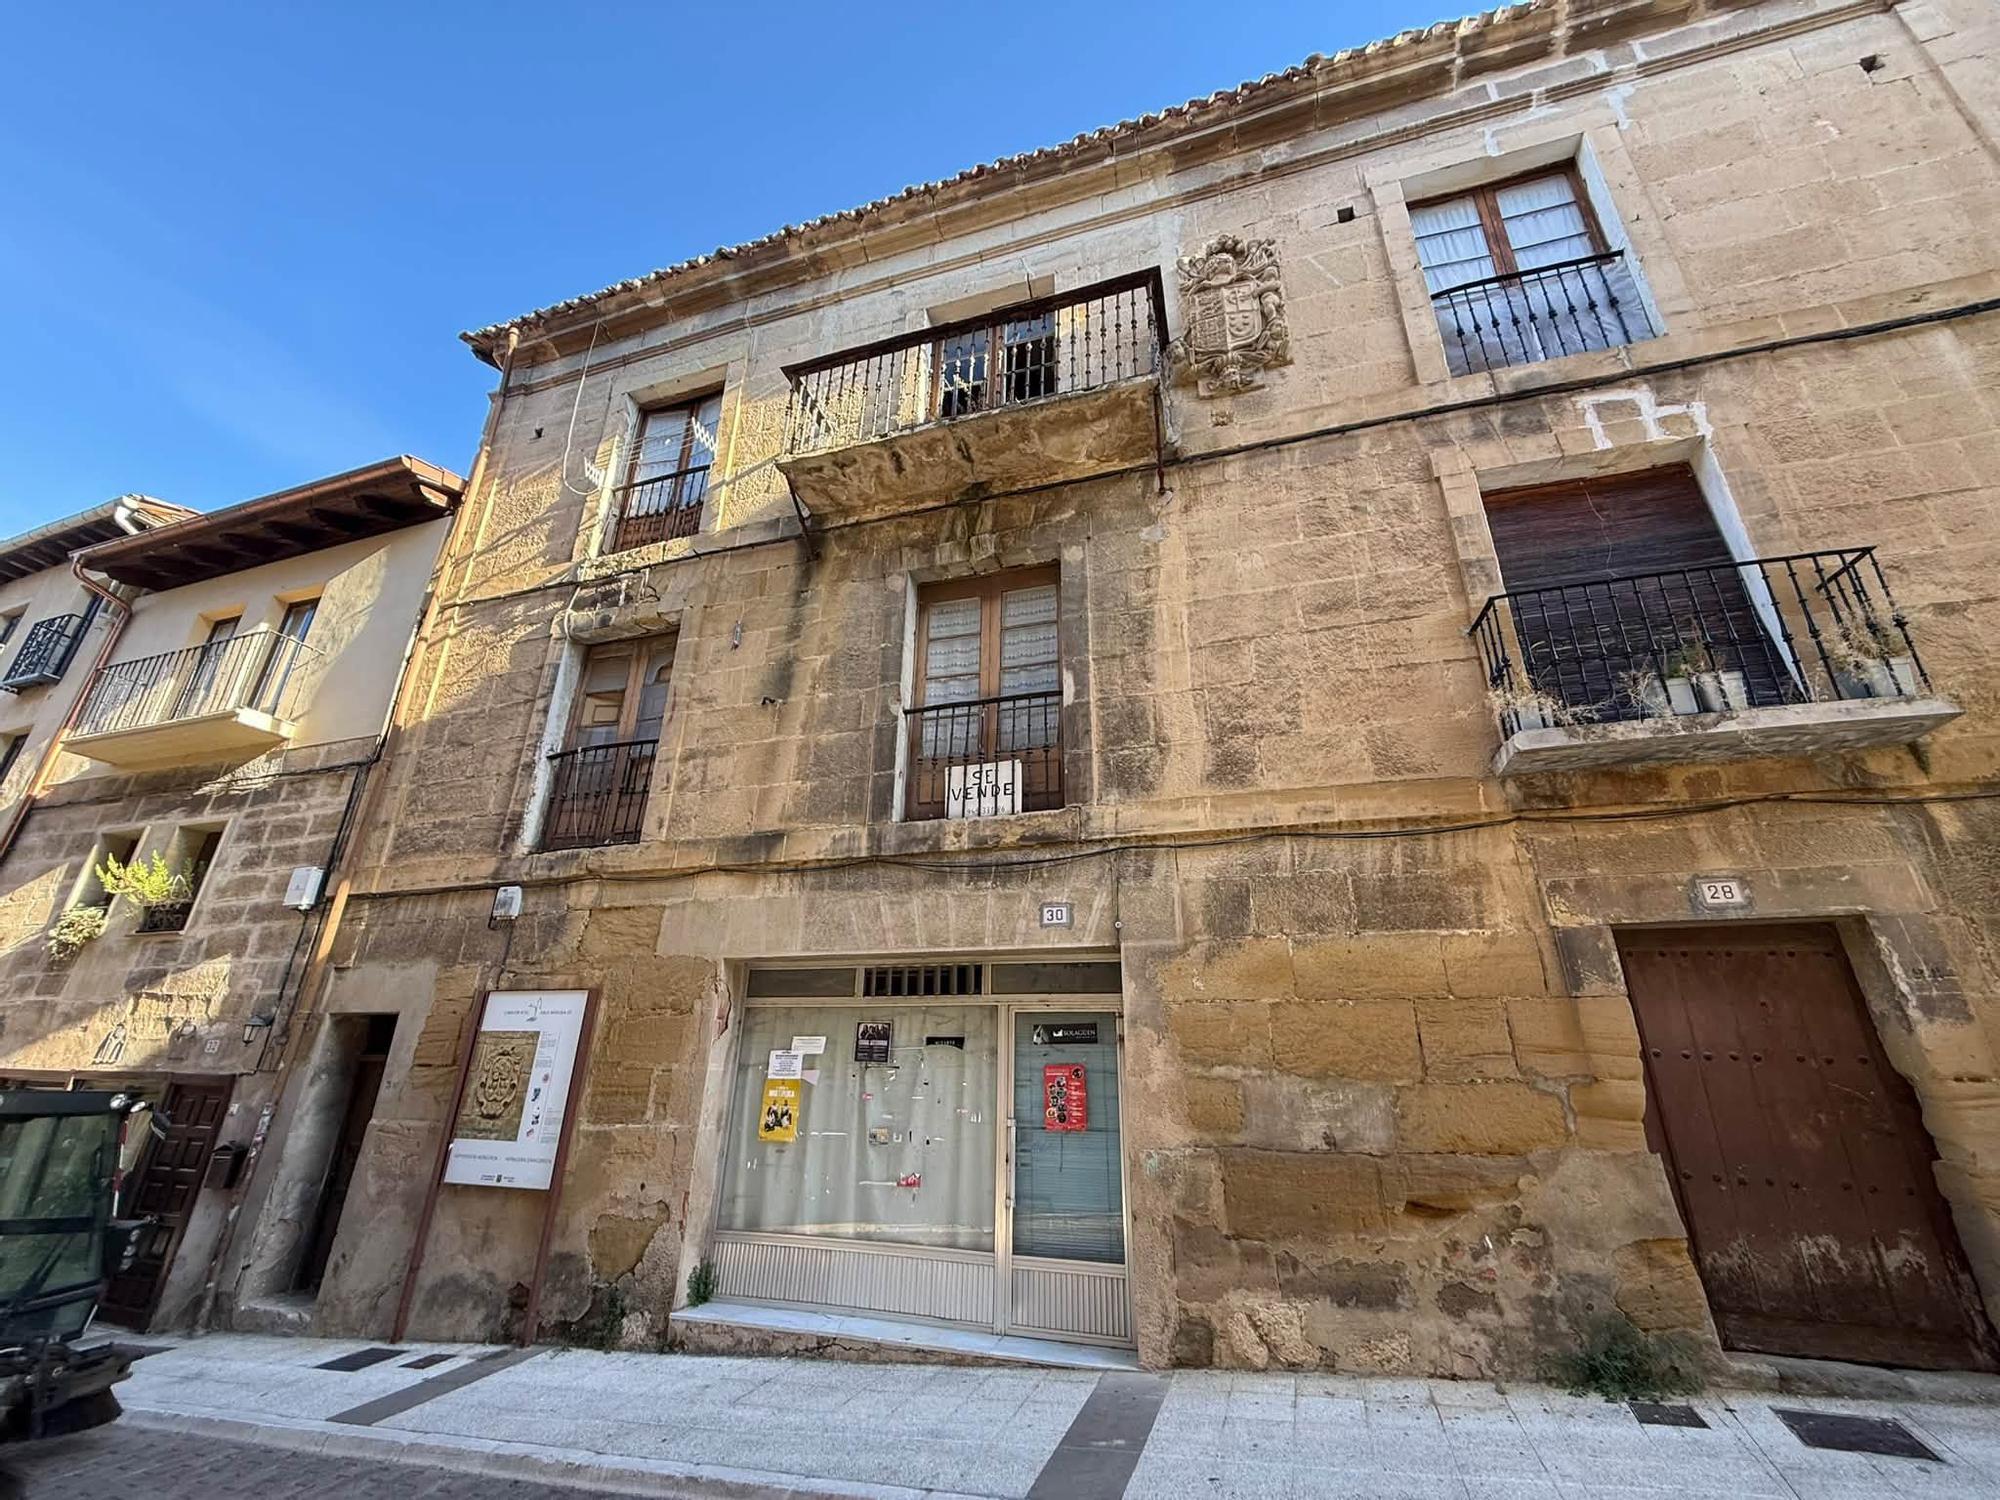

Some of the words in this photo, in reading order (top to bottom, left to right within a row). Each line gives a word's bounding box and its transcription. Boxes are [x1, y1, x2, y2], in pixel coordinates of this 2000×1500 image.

[972, 769, 993, 786] SE
[951, 782, 1014, 801] VENDE
[1707, 885, 1734, 900] 28
[1046, 909, 1063, 921] 30
